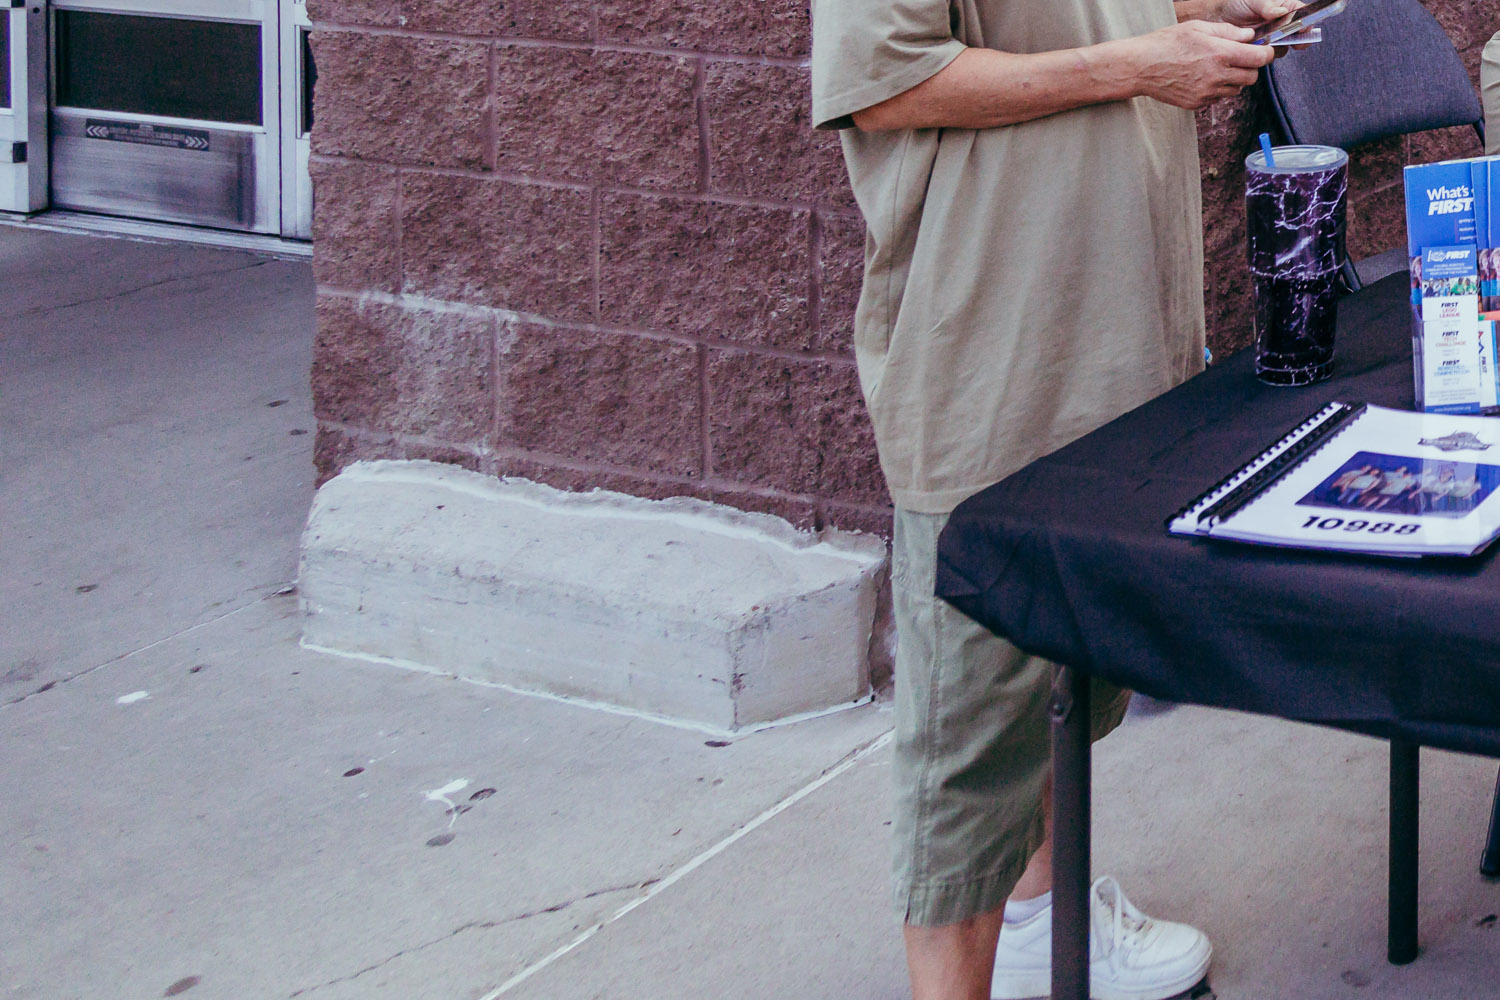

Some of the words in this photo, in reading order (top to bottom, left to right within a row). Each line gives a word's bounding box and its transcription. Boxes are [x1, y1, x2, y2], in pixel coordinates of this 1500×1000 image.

[1426, 185, 1469, 201] What's
[1428, 197, 1474, 216] FIRST
[1301, 515, 1422, 536] 10988
